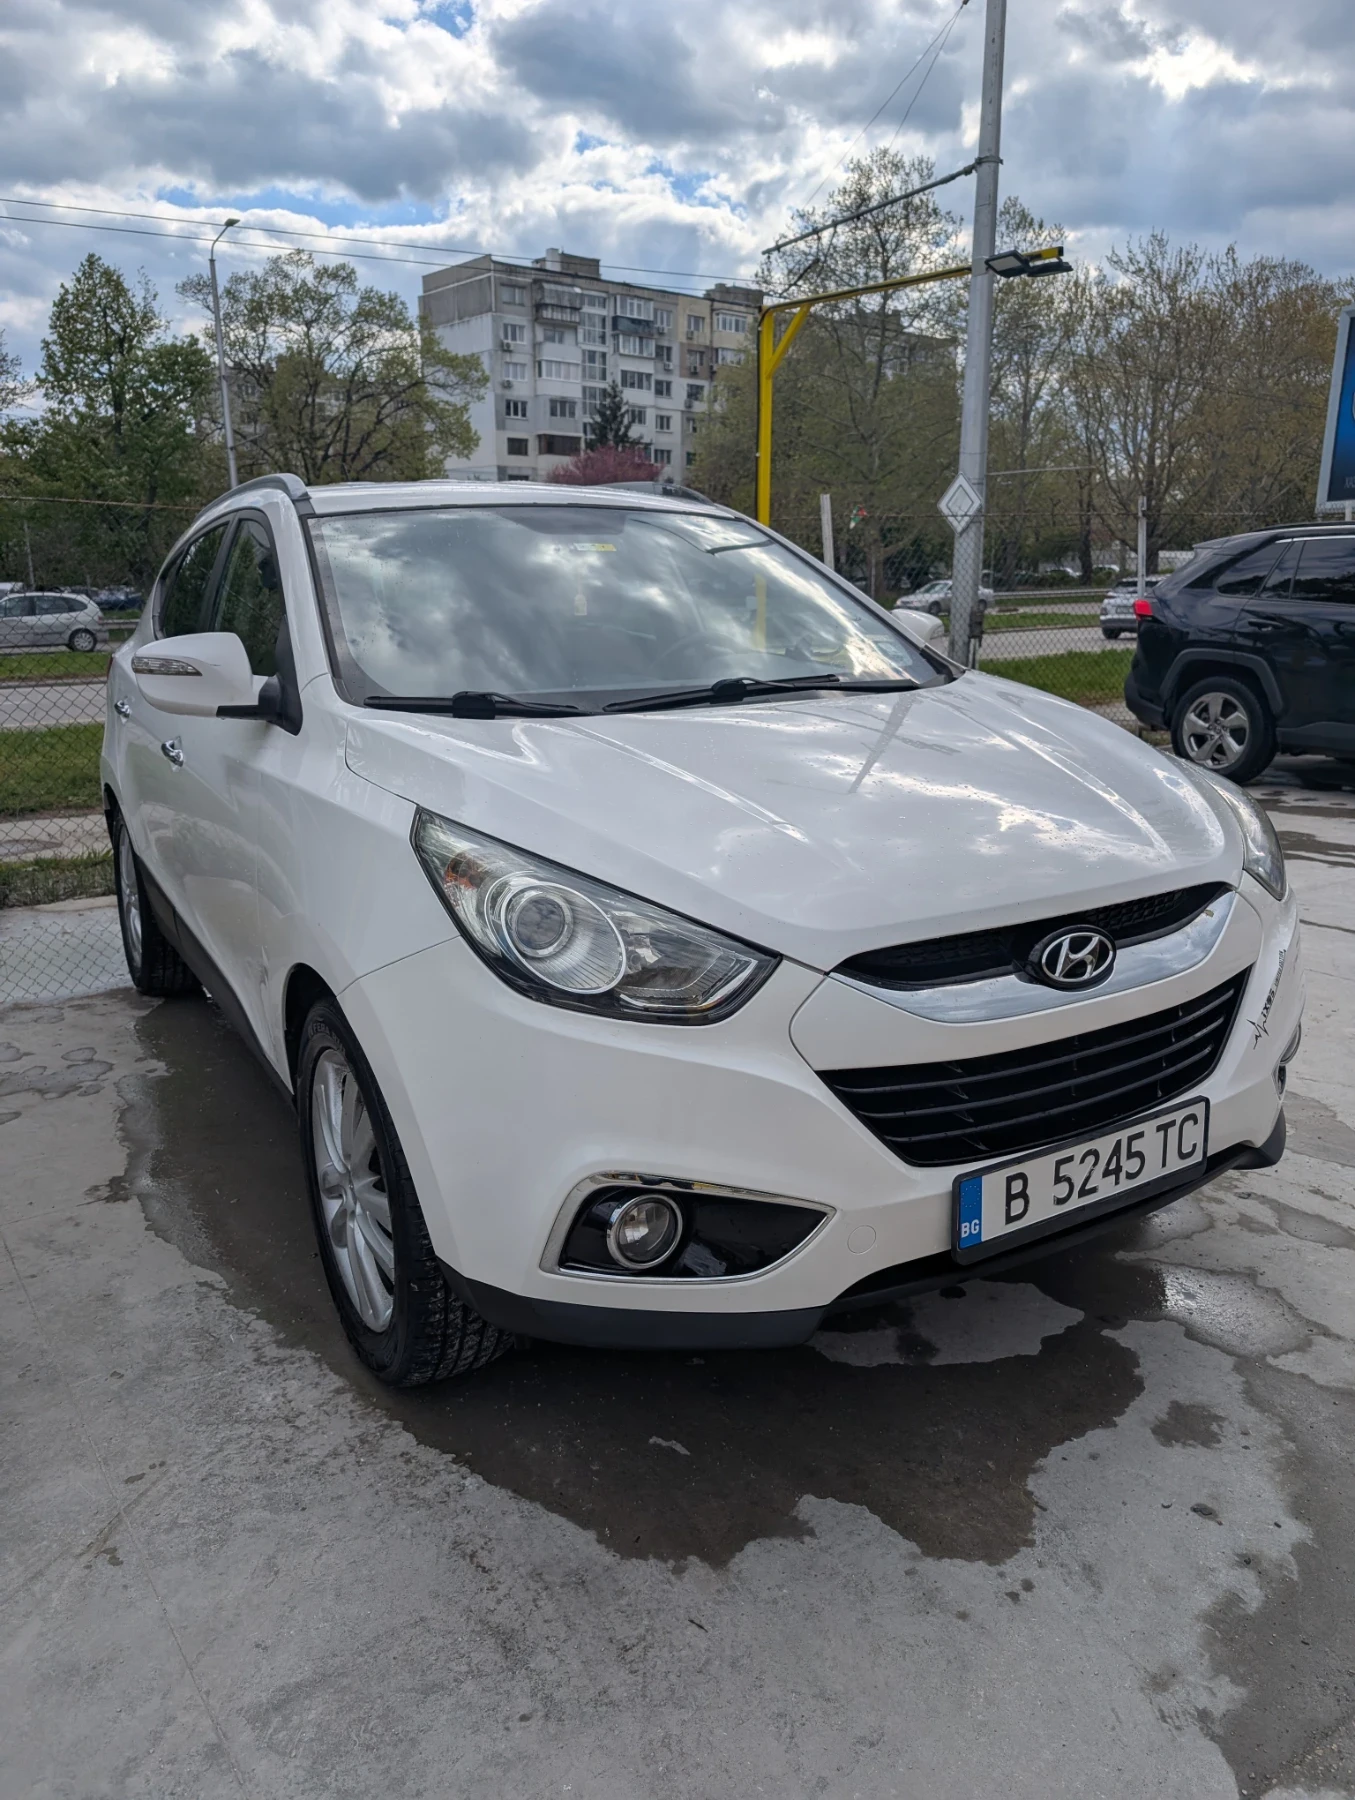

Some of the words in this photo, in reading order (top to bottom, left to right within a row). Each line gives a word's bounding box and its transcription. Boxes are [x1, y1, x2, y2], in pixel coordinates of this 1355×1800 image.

[1004, 1171, 1030, 1226] B
[1052, 1130, 1146, 1206] 5245
[1156, 1112, 1199, 1169] TC
[961, 1218, 980, 1238] BG
